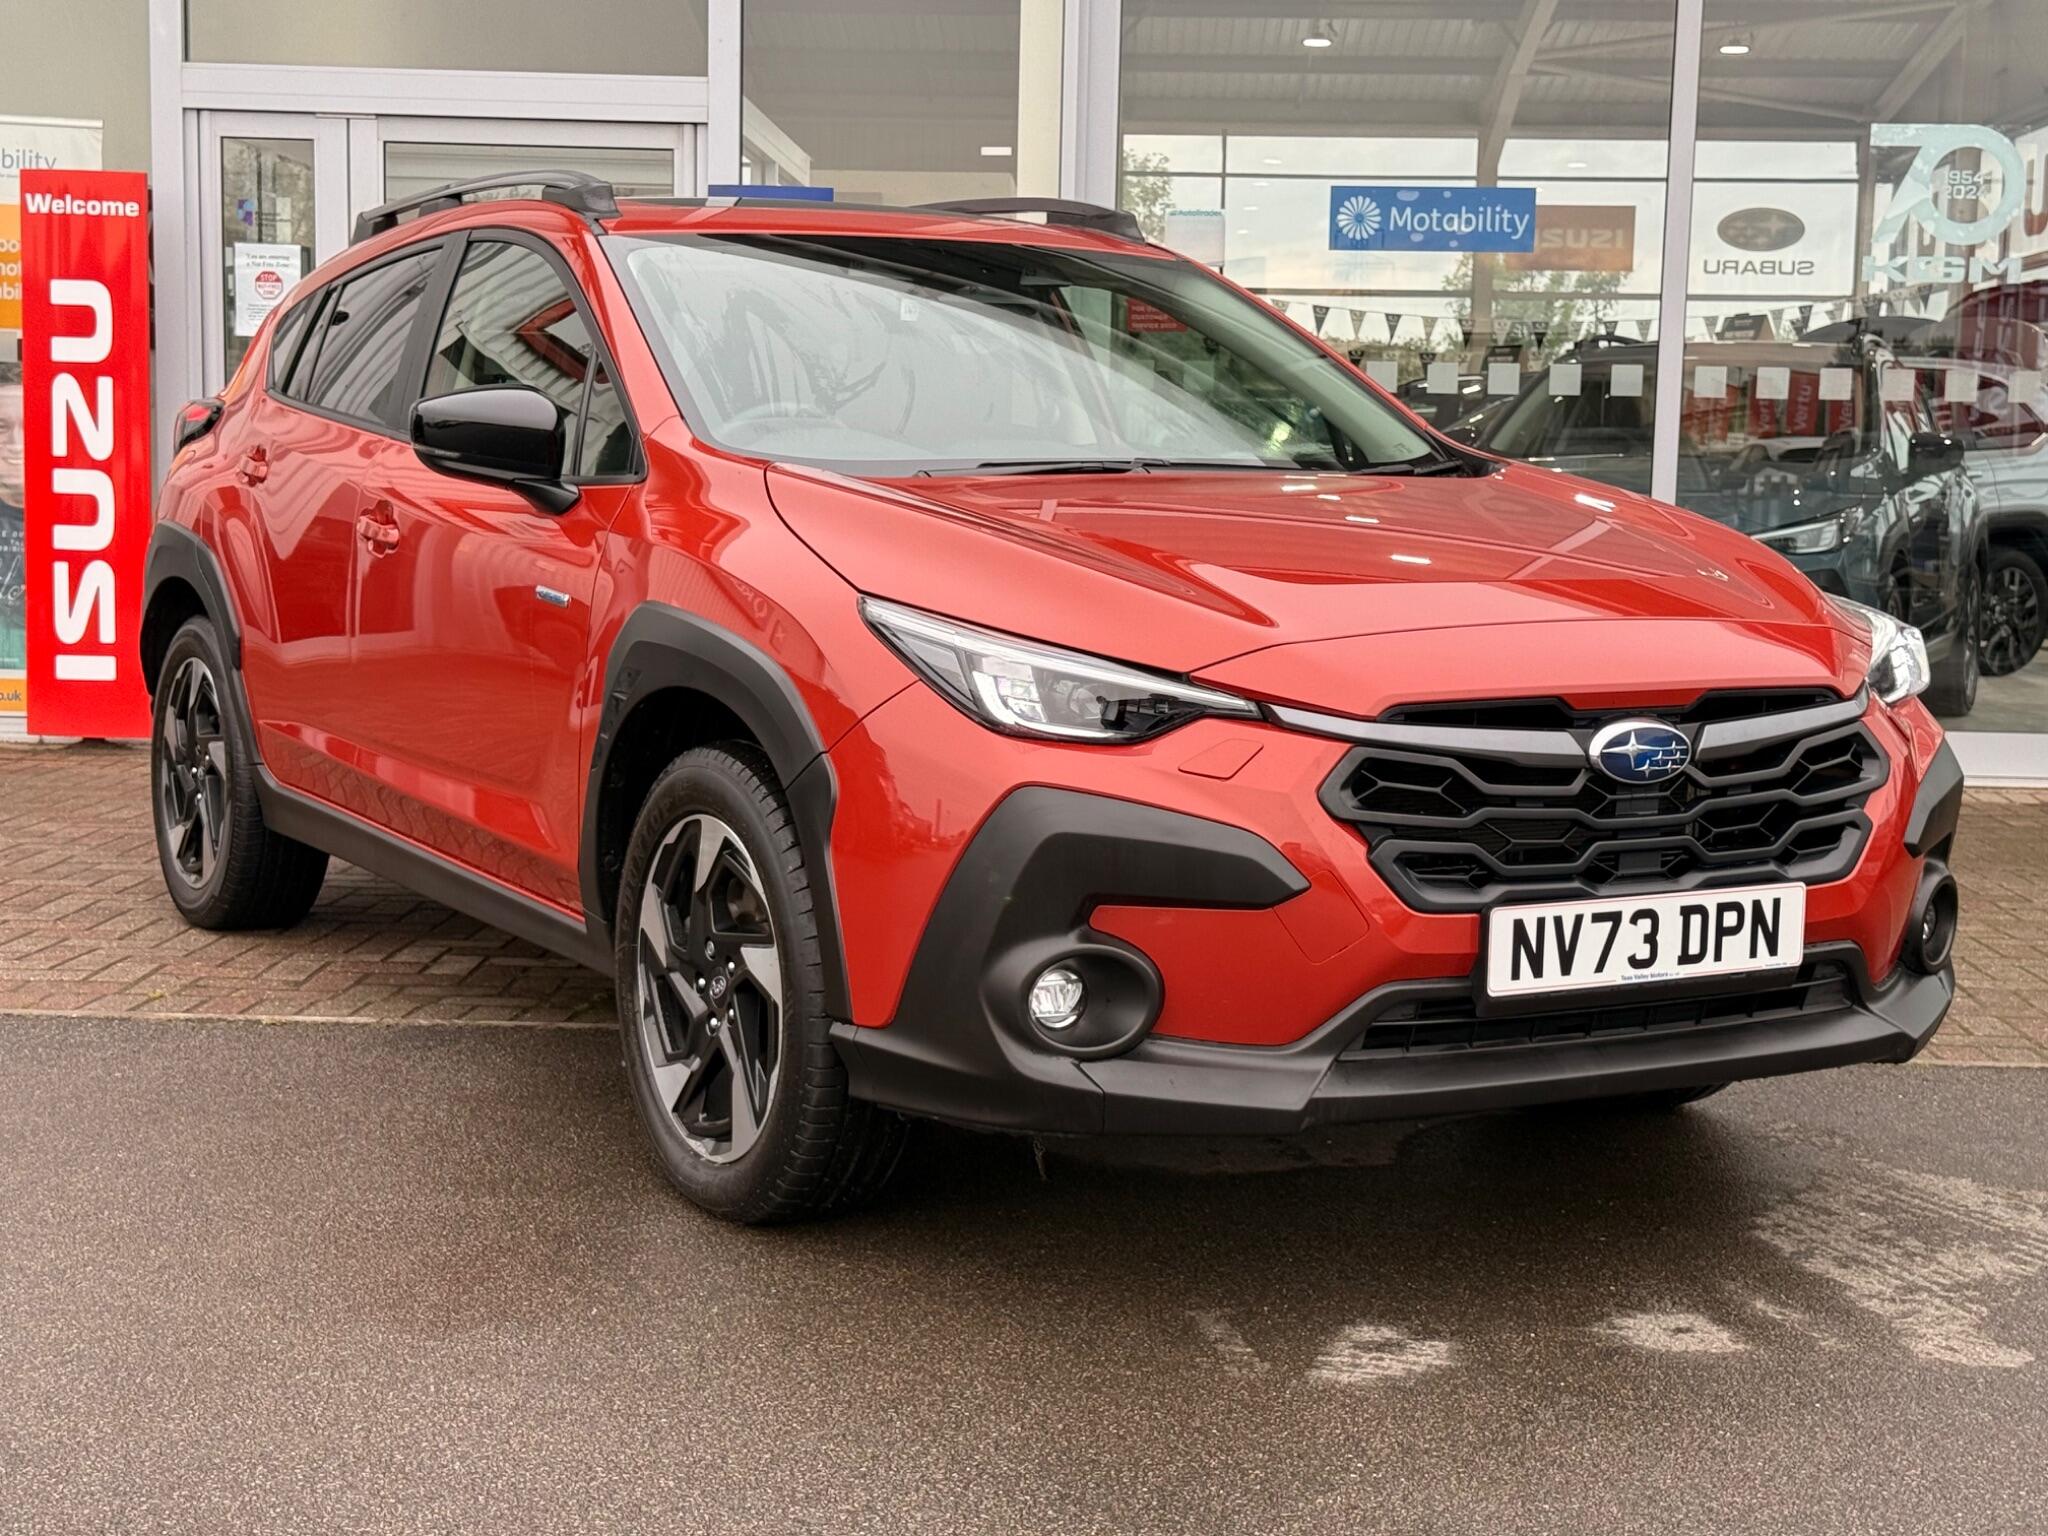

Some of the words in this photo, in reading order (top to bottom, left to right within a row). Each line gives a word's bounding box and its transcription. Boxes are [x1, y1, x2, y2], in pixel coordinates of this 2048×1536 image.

[25, 193, 140, 217] Welcome
[1389, 204, 1530, 240] Motability
[50, 278, 117, 681] ISUZU
[1511, 908, 1660, 981] NV73
[1677, 897, 1782, 967] DPN
